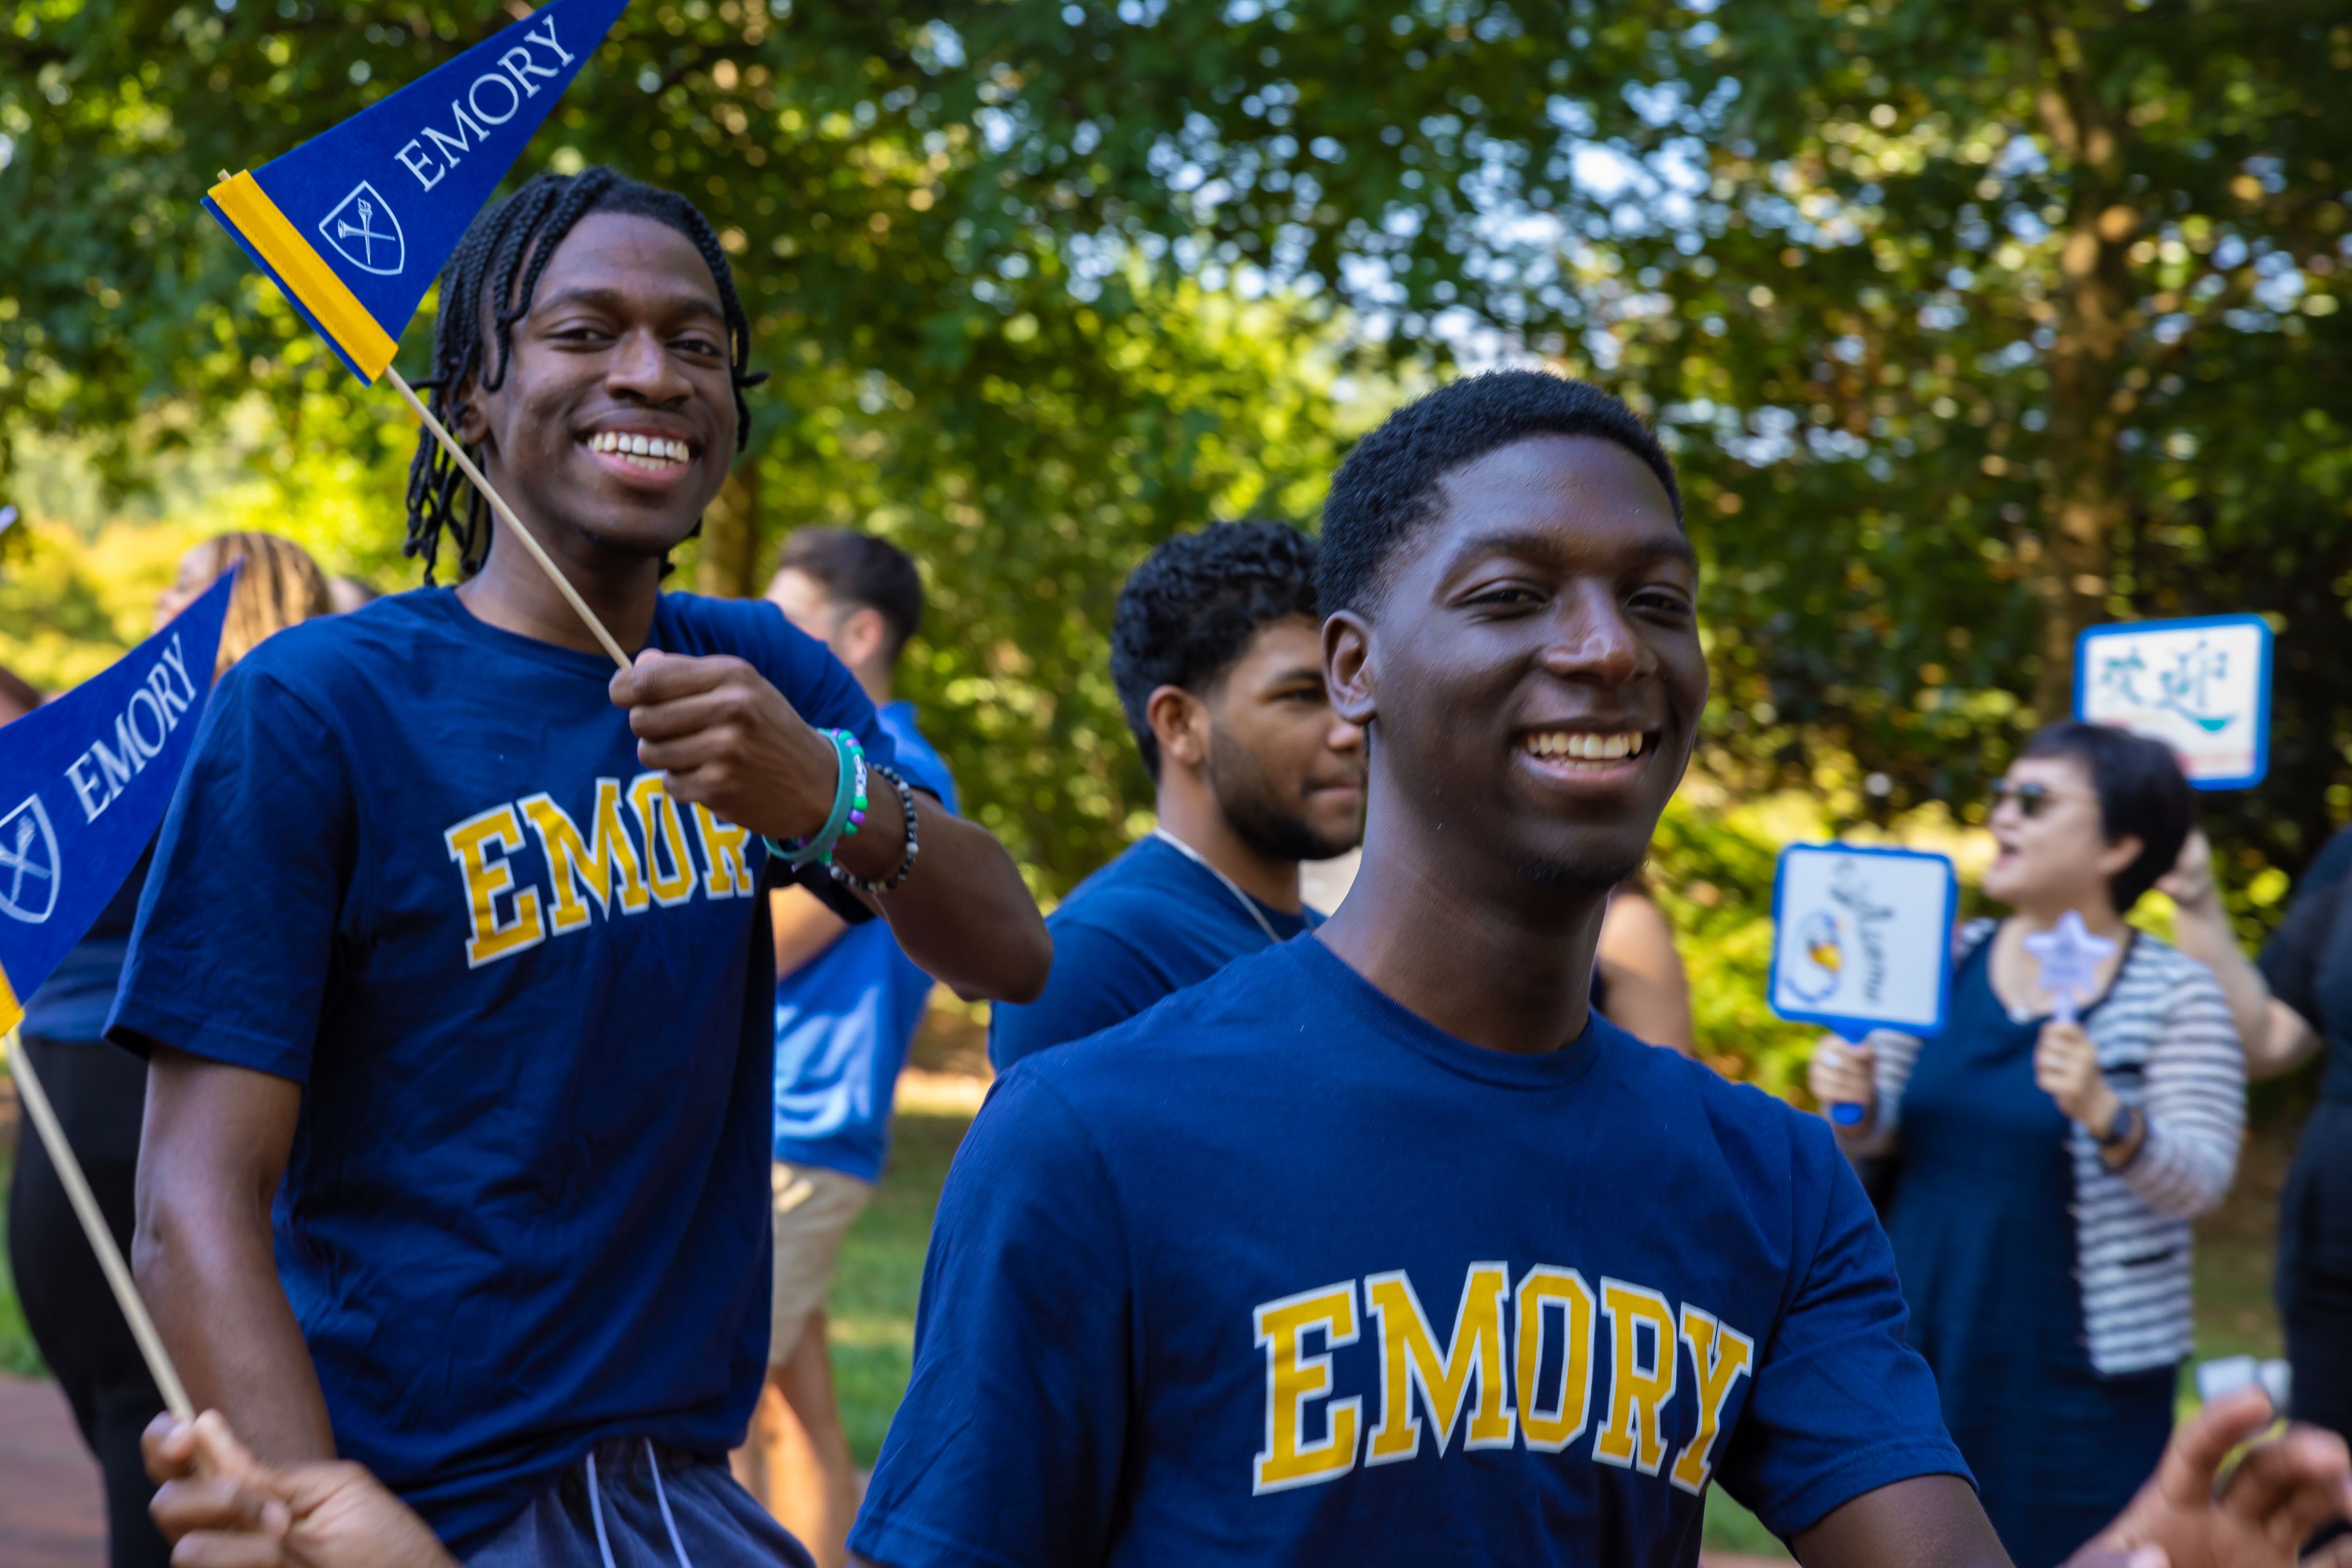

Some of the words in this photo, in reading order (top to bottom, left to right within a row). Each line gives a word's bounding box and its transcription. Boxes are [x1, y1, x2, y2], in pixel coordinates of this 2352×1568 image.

[394, 13, 575, 193] EMORY
[64, 632, 197, 824] EMORY
[1252, 1261, 1754, 1496] EMORY
